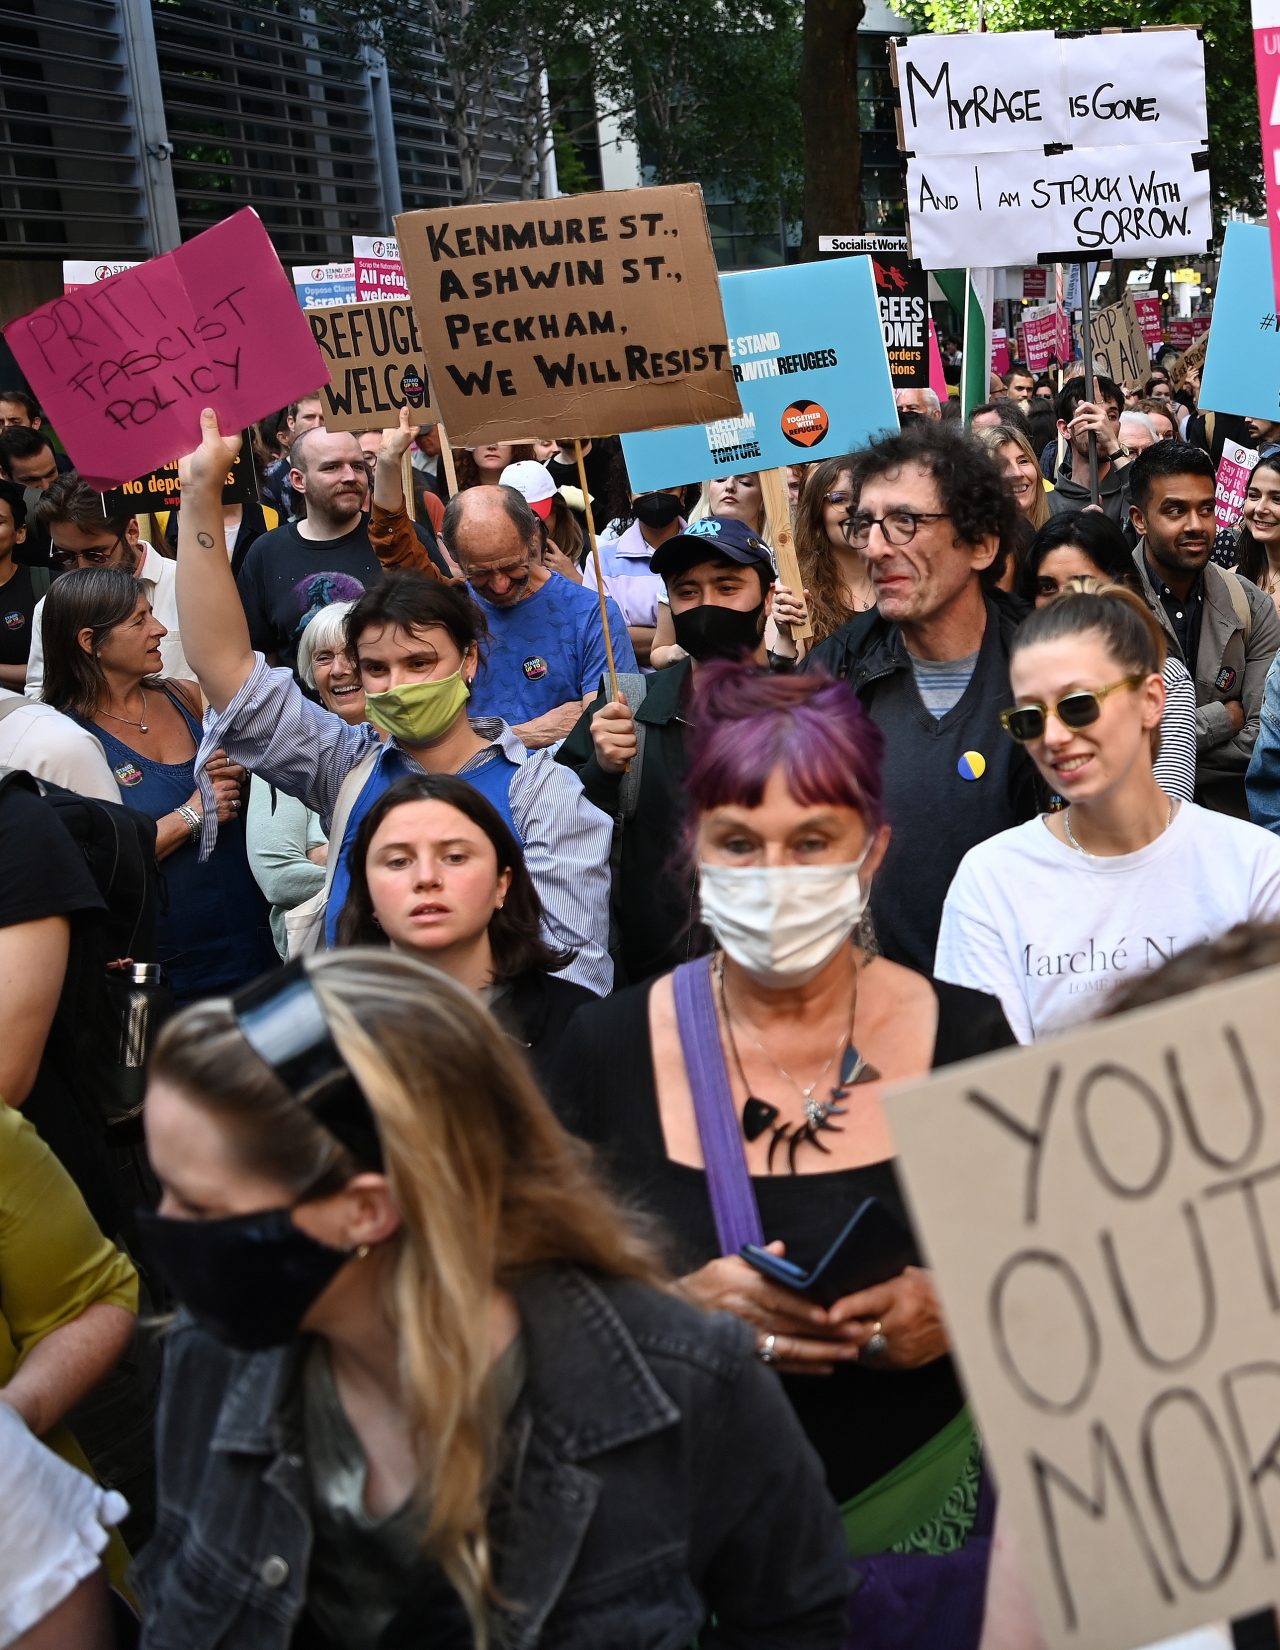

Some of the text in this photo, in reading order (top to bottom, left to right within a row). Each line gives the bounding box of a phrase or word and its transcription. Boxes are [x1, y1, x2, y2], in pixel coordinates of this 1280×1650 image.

[1069, 95, 1089, 117] IS
[920, 166, 1180, 212] AND I AM STRUCK WITH
[426, 212, 679, 262] KENMURE ST.,
[1073, 206, 1192, 248] SORROW.
[359, 261, 372, 269] Scrap
[360, 269, 377, 284] All
[439, 256, 682, 303] ASHWIN ST.,
[305, 286, 332, 295] Oppose
[26, 275, 168, 374] PRITI
[444, 309, 628, 350] PECKHAM,
[67, 286, 248, 401] FASCIST
[736, 332, 780, 356] STAND
[1029, 351, 1048, 360] here
[446, 344, 728, 398] WE WILL RESIST
[104, 347, 242, 430] POLICY
[787, 412, 820, 424] TOGETHER
[796, 420, 814, 428] WITH
[708, 431, 739, 450] FROM
[789, 424, 823, 435] REFUGEES
[710, 442, 761, 464] TORTURE
[1219, 472, 1240, 489] Say it
[1223, 461, 1243, 478] Say it
[122, 480, 143, 495] No
[524, 659, 540, 667] STAND
[966, 1022, 1265, 1226] YOU
